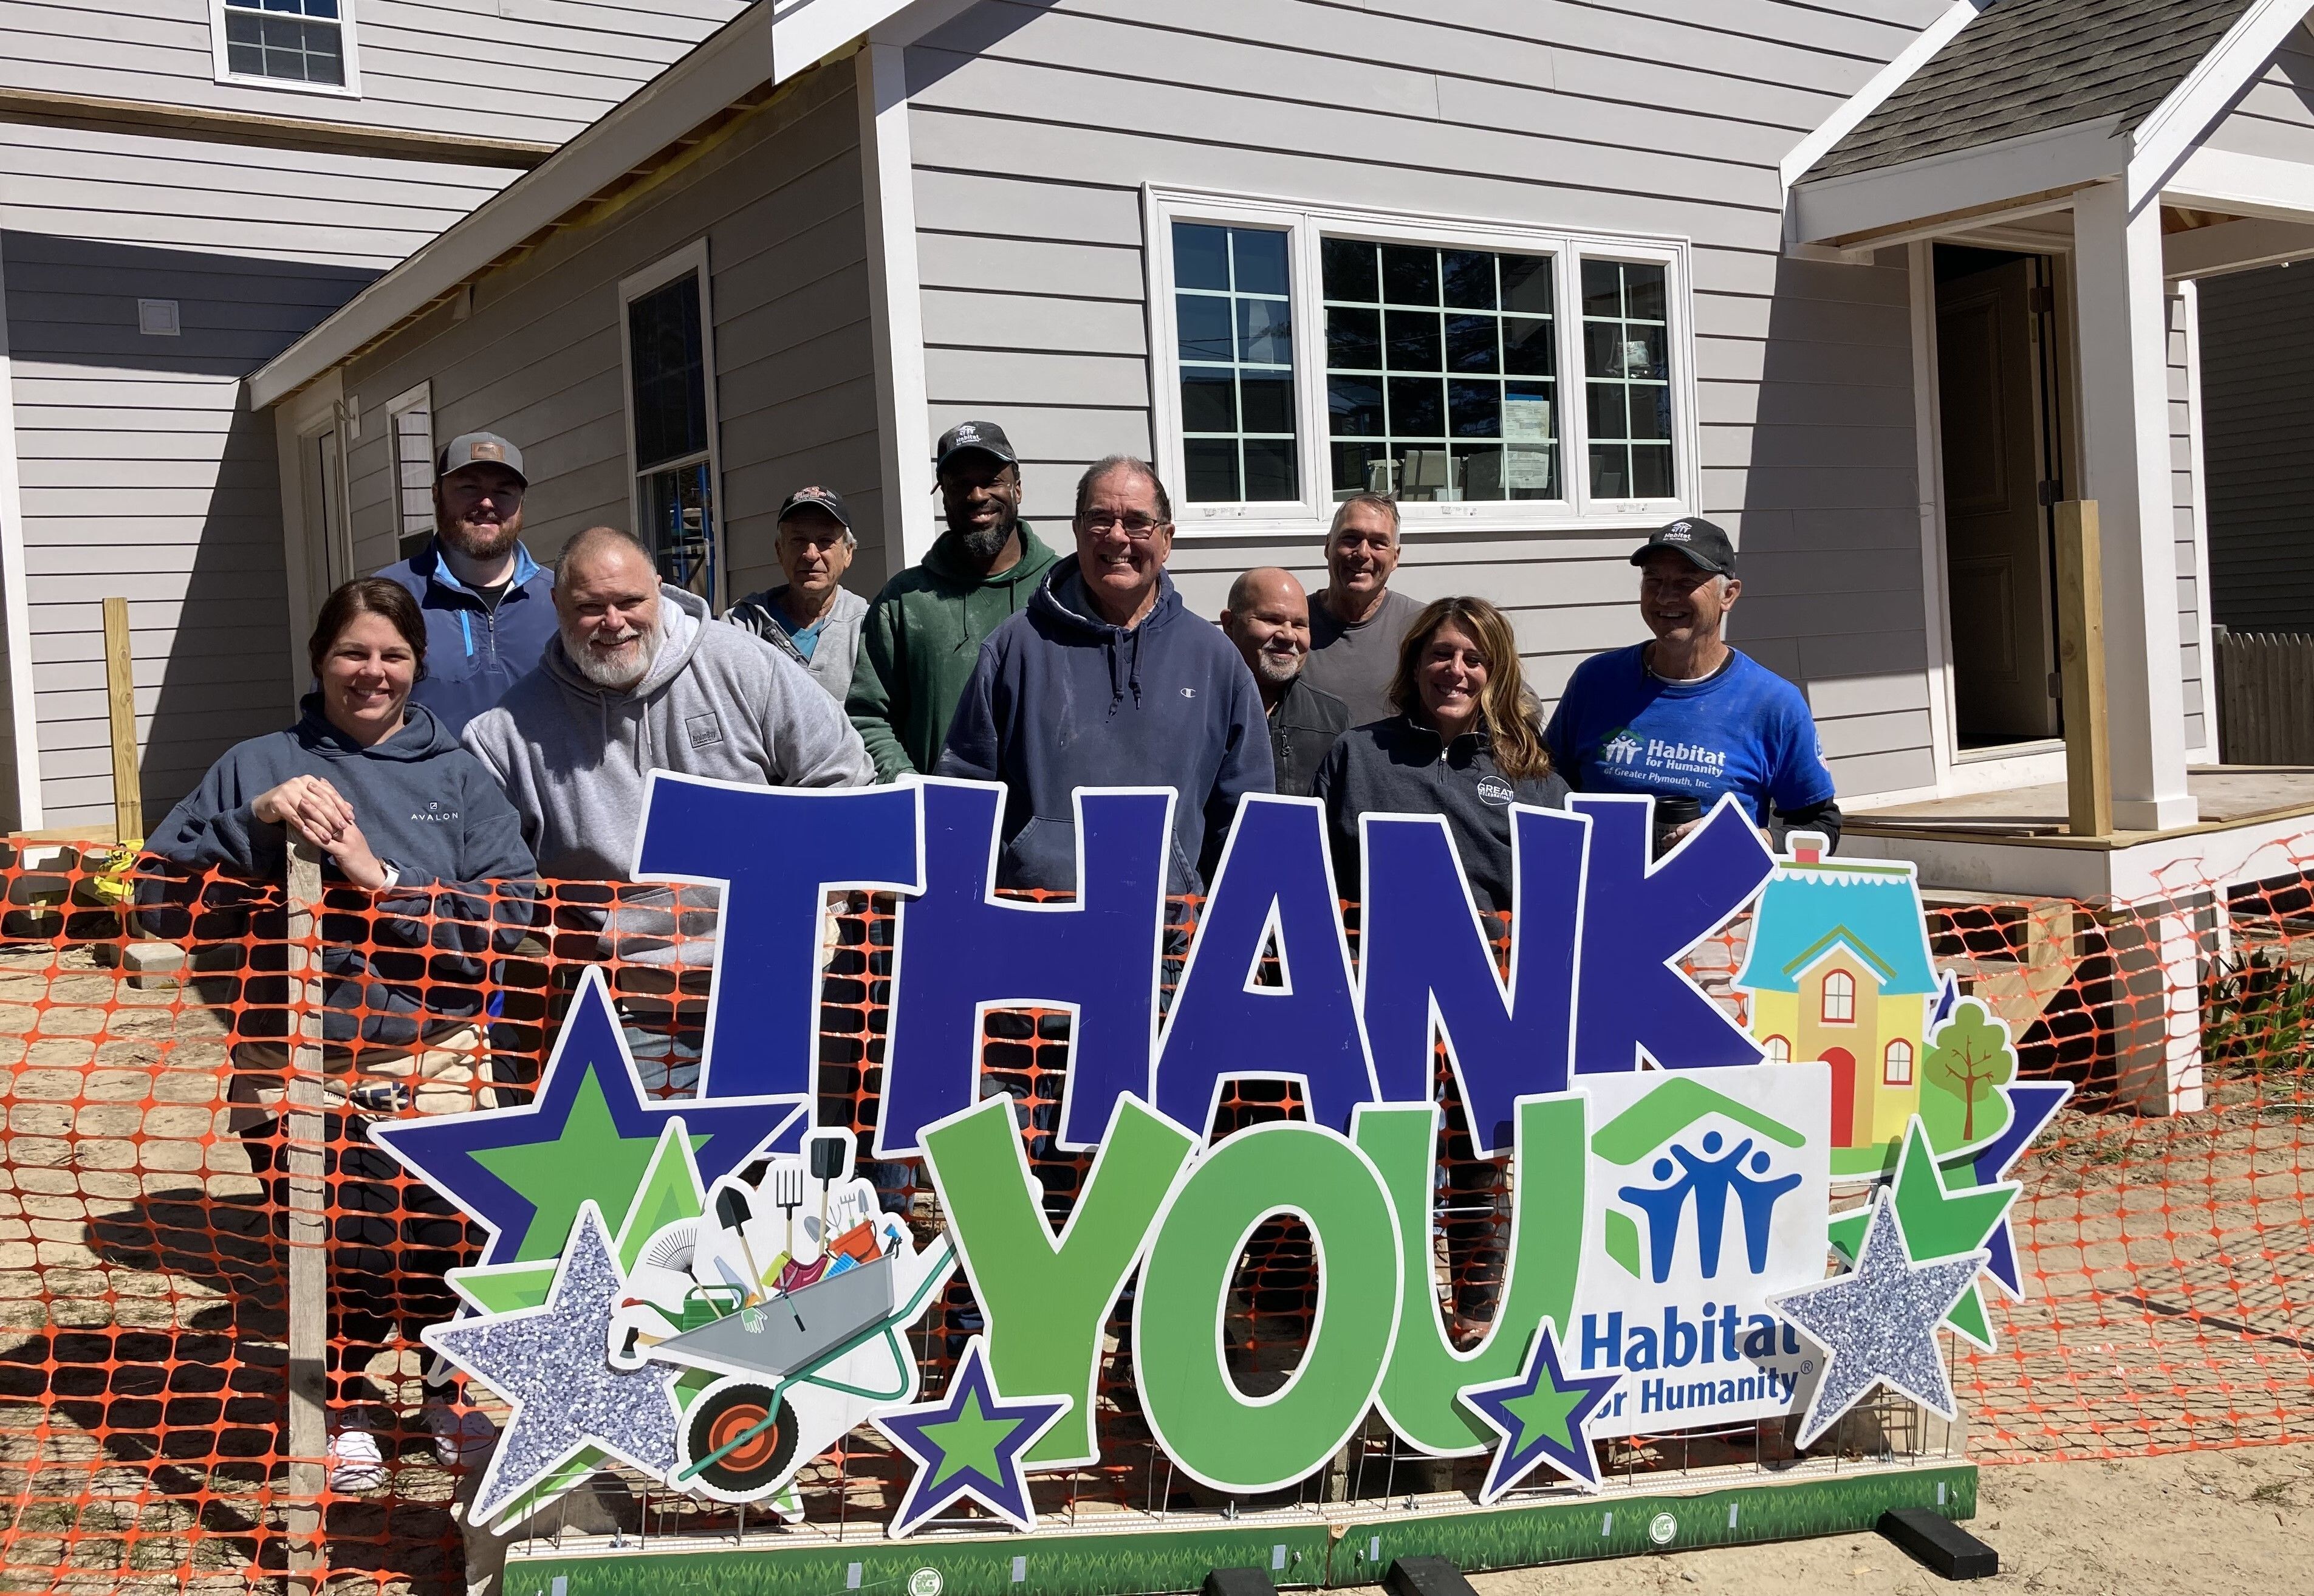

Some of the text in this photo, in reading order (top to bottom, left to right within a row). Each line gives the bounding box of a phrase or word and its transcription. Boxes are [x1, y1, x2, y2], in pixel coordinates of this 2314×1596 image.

[1646, 756, 1724, 778] for Humanity
[1647, 739, 1727, 767] Habitat
[1477, 783, 1513, 797] GREAT
[1615, 767, 1647, 780] Greater
[1649, 772, 1692, 787] Plymouth,
[1695, 778, 1711, 789] Inc.
[411, 812, 458, 821] AVALON
[632, 769, 1775, 1159] THANK
[917, 1091, 1592, 1495] YOU
[1581, 1302, 1800, 1372] Habitat
[1641, 1366, 1799, 1414] Humanity
